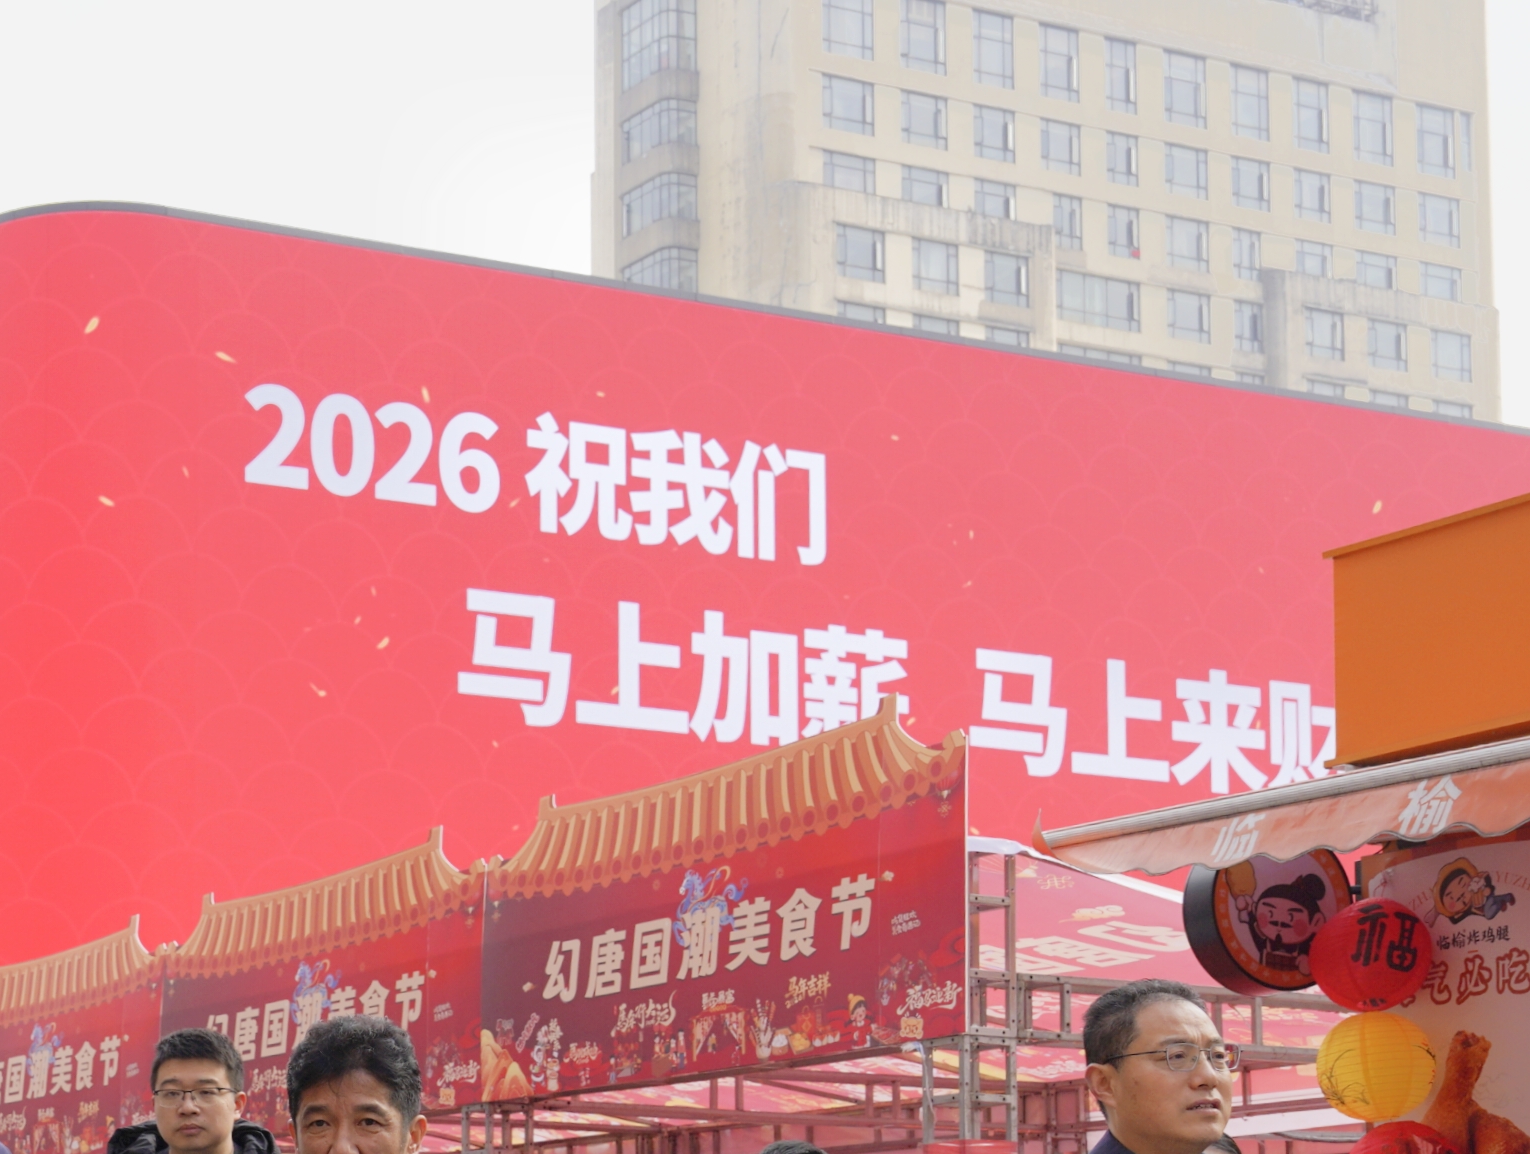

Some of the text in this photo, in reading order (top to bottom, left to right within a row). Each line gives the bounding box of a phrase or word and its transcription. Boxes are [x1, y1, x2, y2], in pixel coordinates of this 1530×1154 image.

[243, 383, 827, 566] 2026 祝我们
[457, 588, 1336, 794] 马上加薪 马上来财
[542, 873, 876, 1003] 幻唐国潮美食节
[1351, 903, 1420, 973] 福
[1400, 947, 1530, 1008] 气必吃
[1436, 925, 1511, 951] 临榆炸鸡腿
